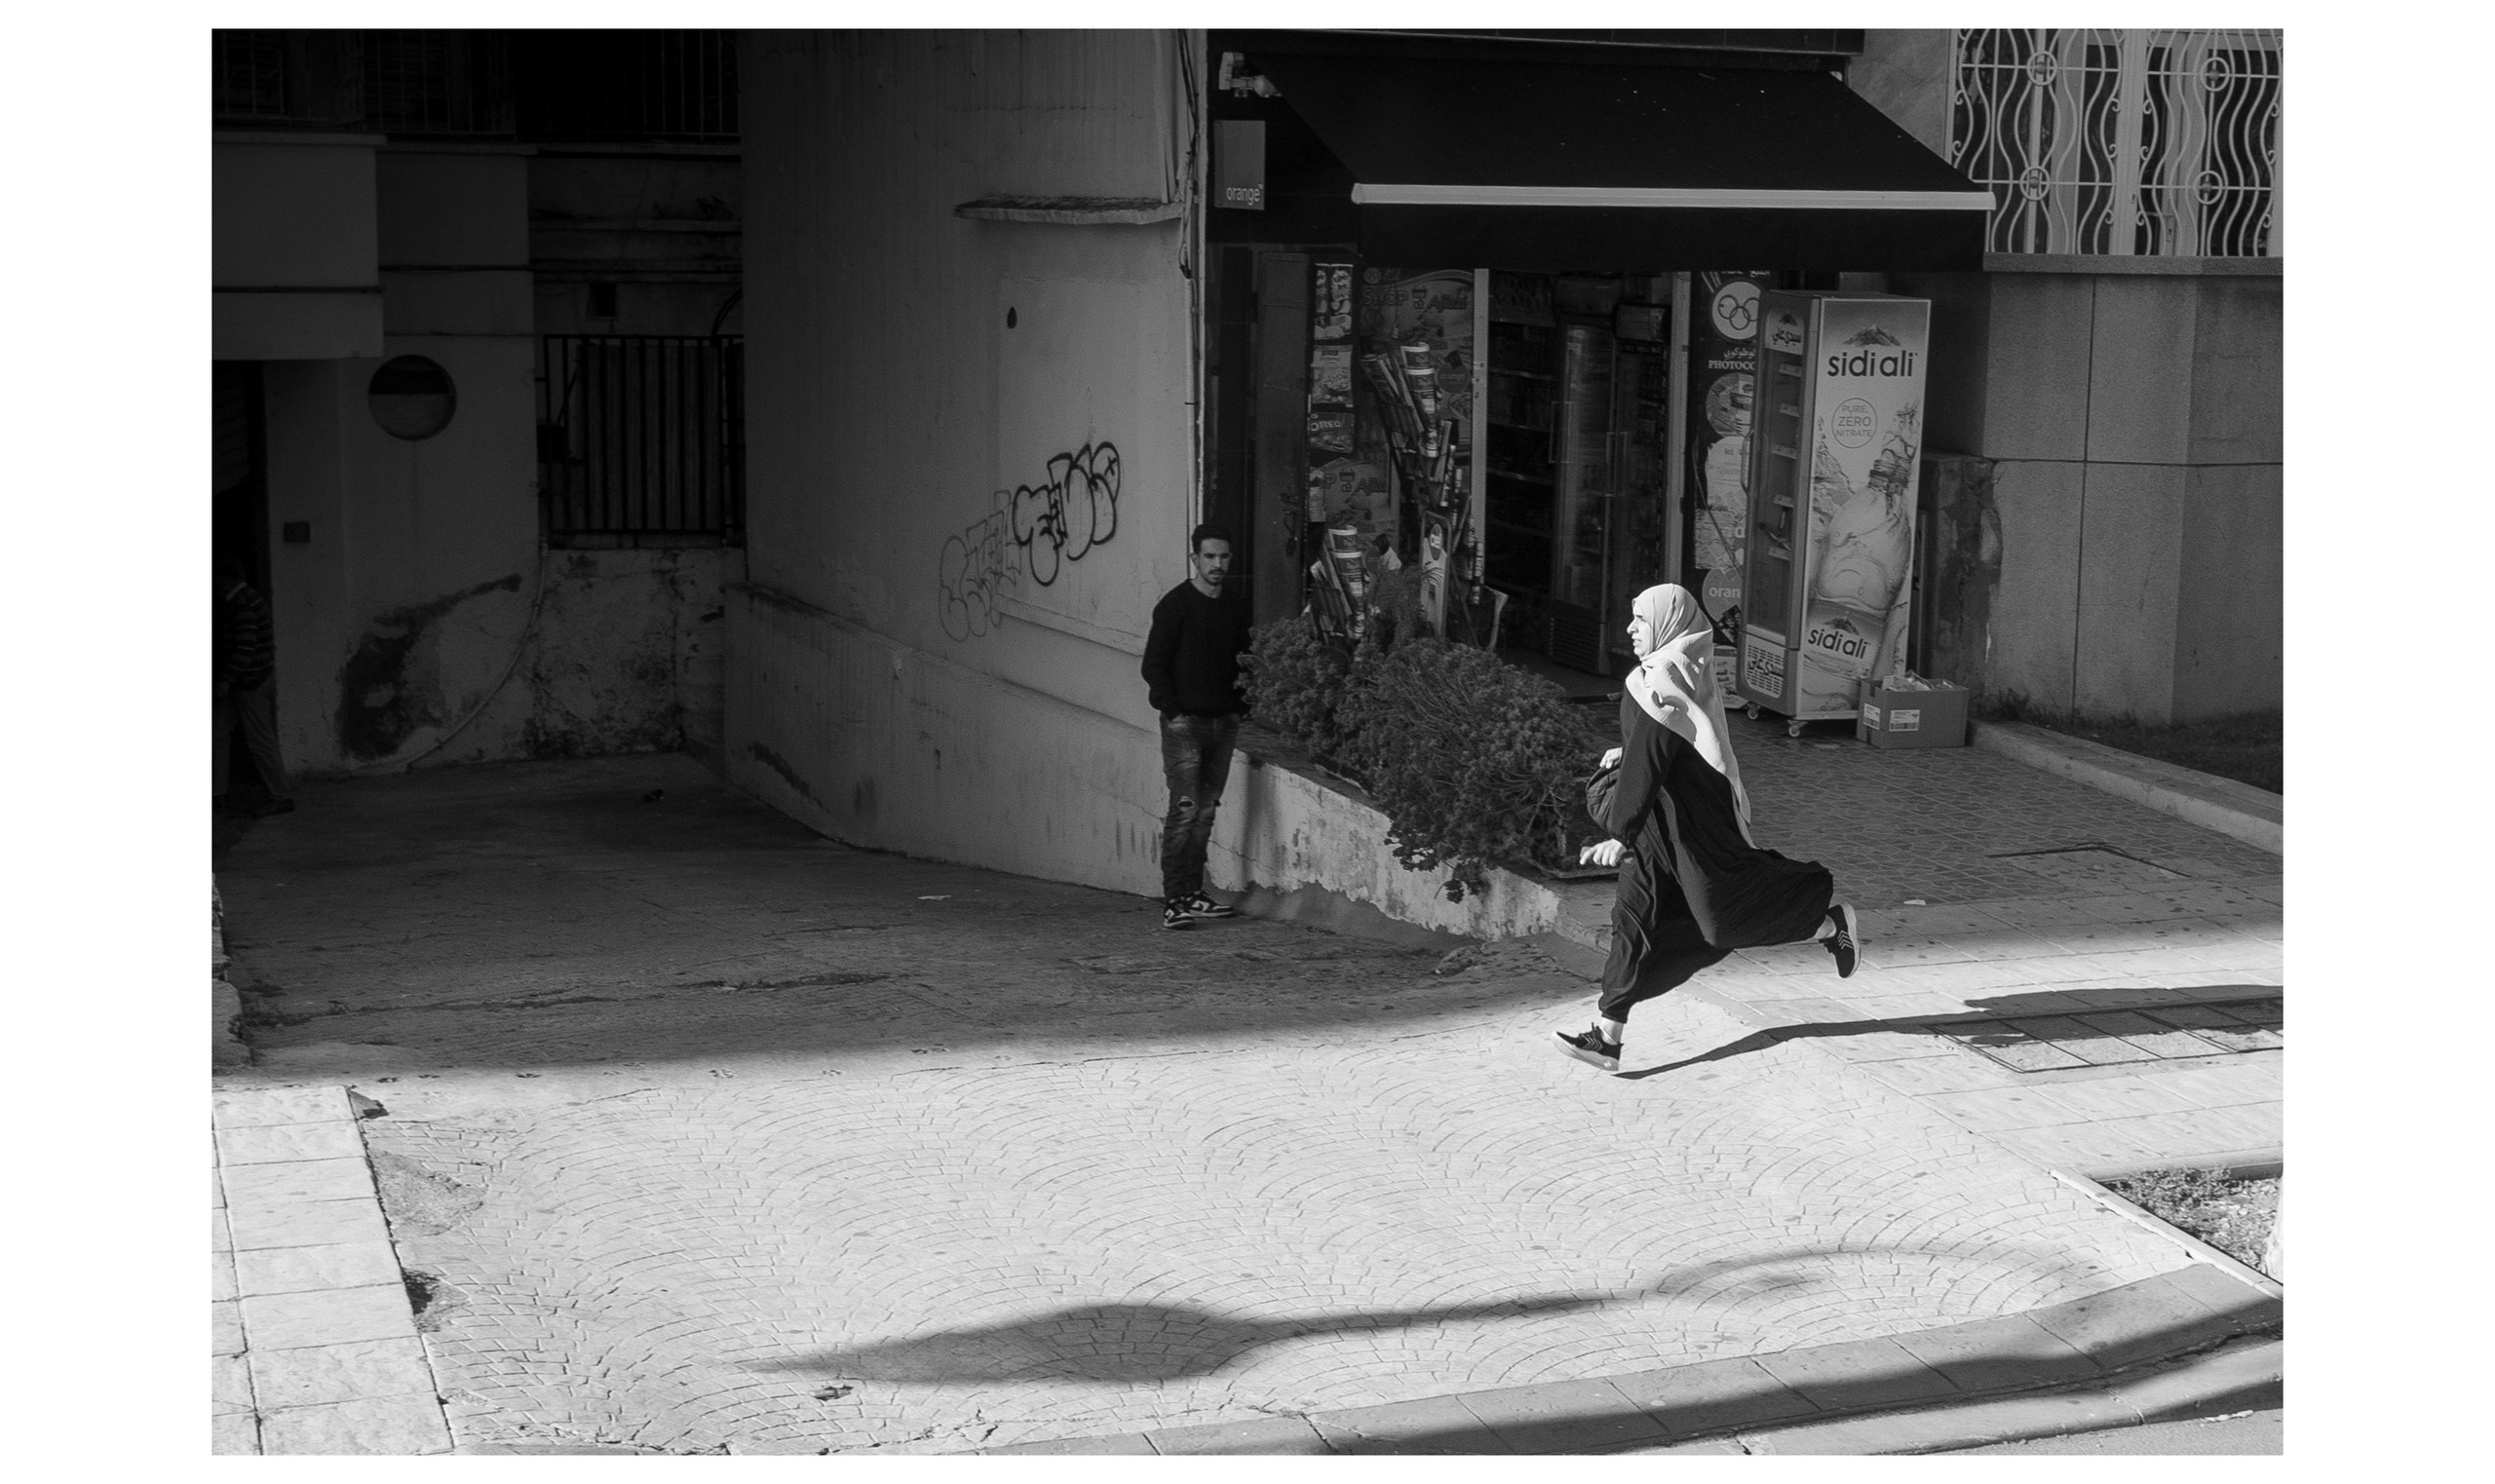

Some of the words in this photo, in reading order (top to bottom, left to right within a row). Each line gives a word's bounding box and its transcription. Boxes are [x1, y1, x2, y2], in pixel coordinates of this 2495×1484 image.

[1225, 186, 1261, 207] orange
[1842, 404, 1868, 414] PURE
[1310, 420, 1342, 432] OREO
[1837, 416, 1872, 427] ZERO
[1835, 429, 1873, 438] NITRATE
[1708, 586, 1742, 598] oran
